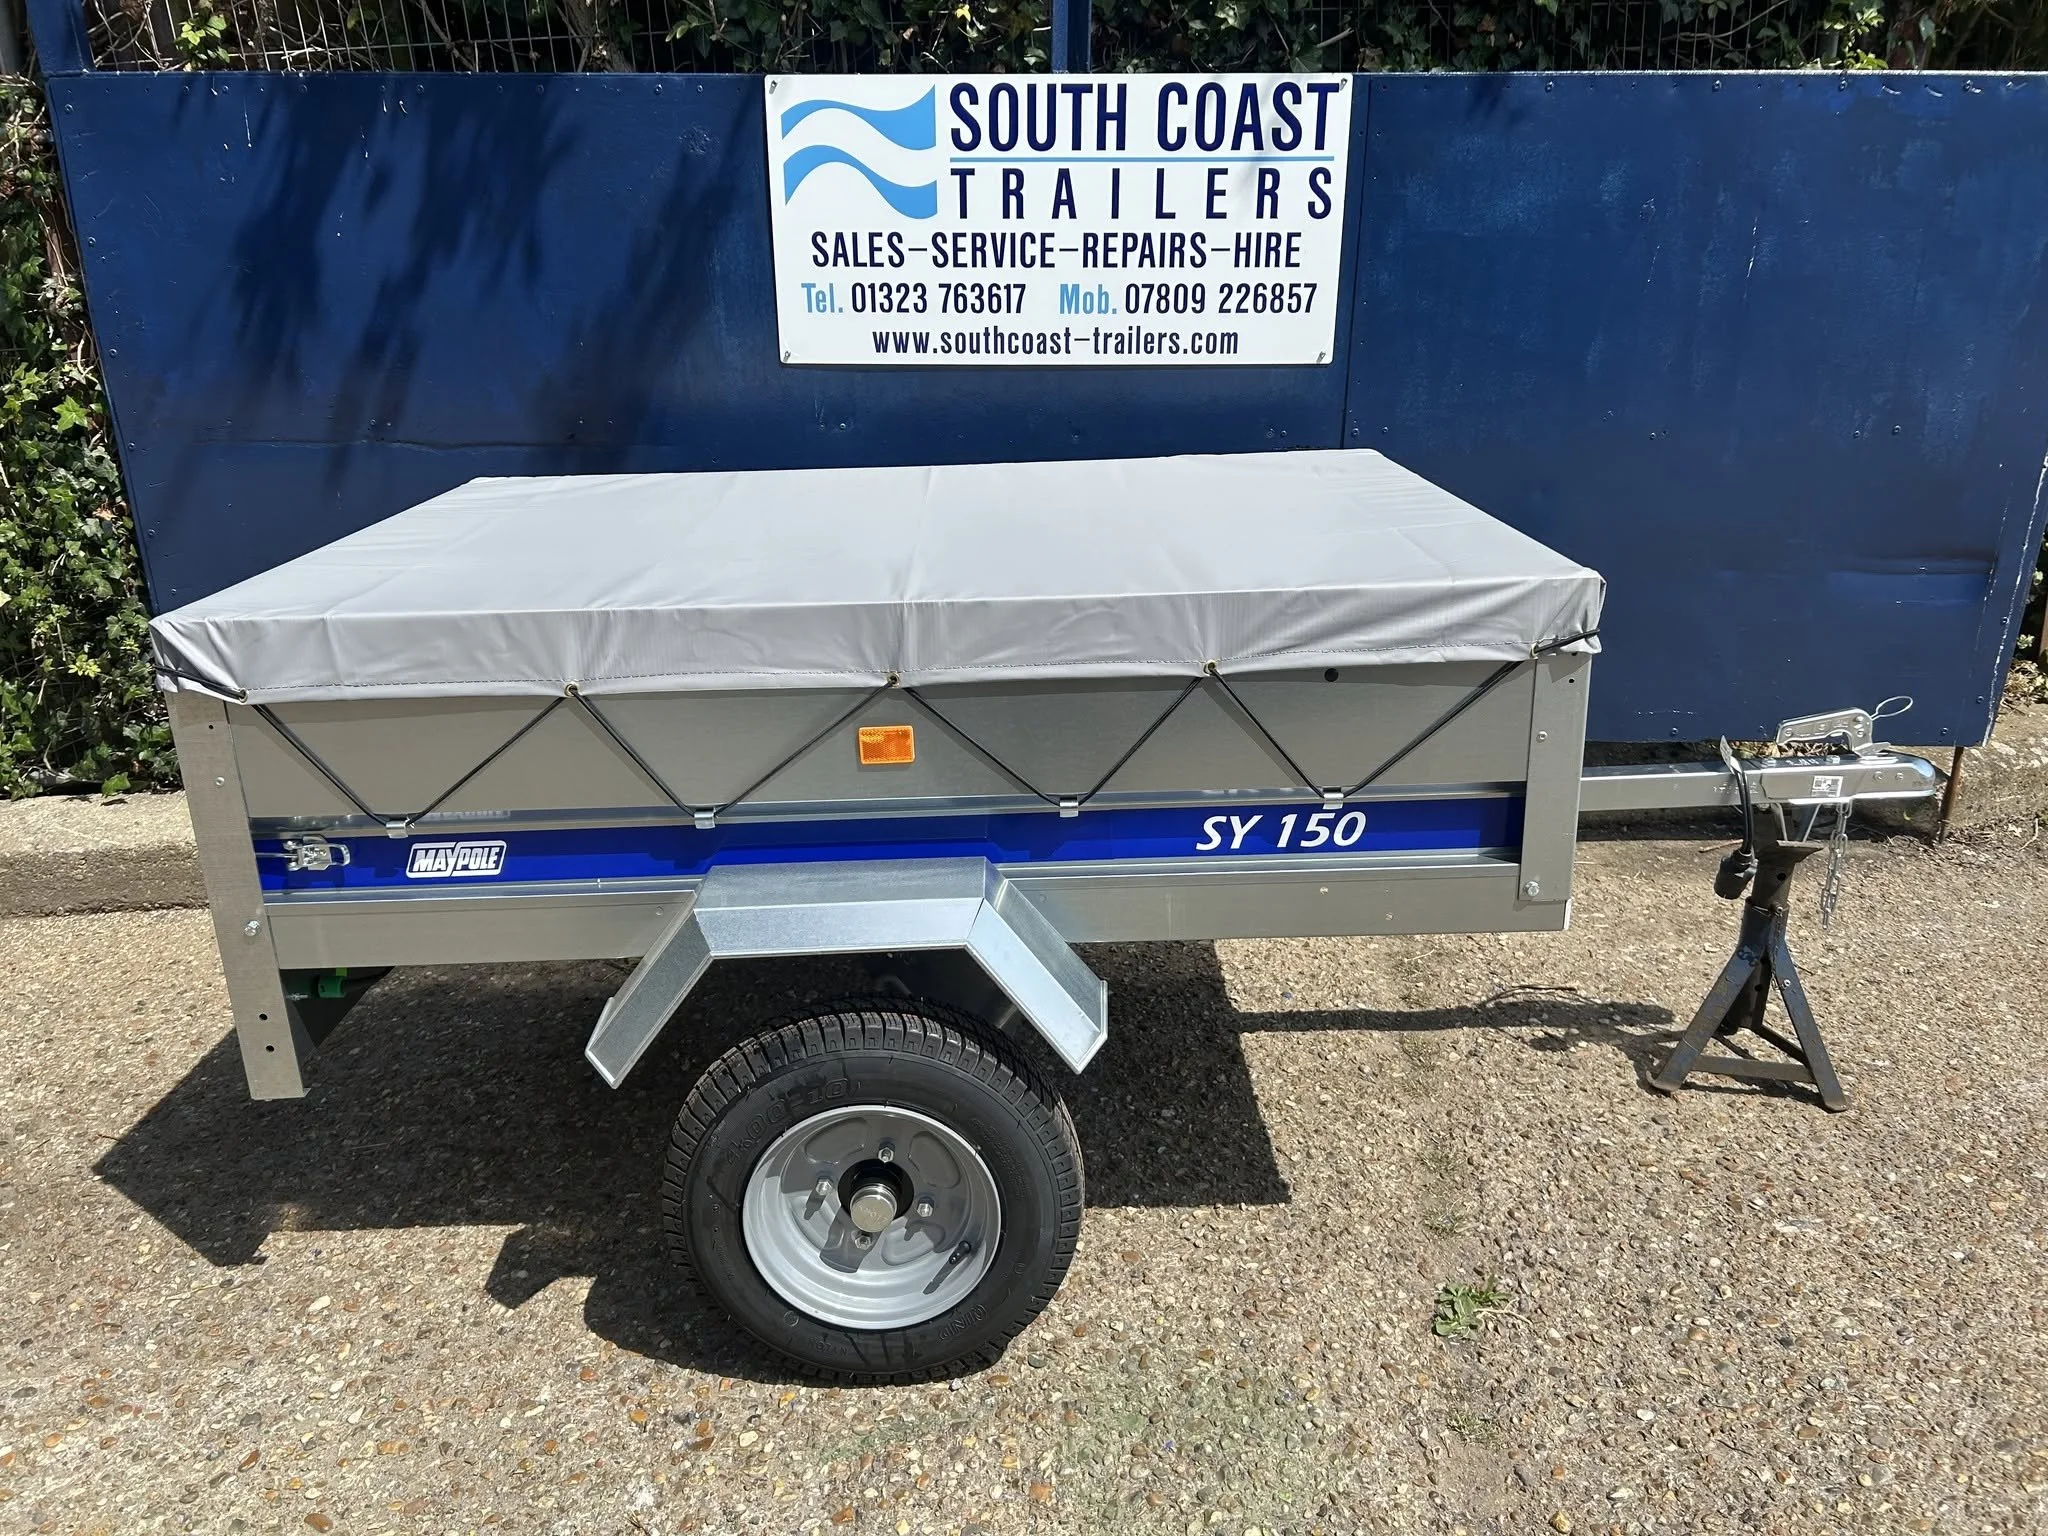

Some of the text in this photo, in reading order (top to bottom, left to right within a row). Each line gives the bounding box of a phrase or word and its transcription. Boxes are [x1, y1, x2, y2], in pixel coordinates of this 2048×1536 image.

[950, 81, 1341, 152] SOUTH COAST
[950, 166, 1333, 220] TRAILERS
[801, 281, 1319, 315] Tel. 01323 763617 Mob. 07809 226857
[872, 325, 1239, 356] www.southcoast-trailers.com
[1195, 811, 1366, 850] SY 150
[411, 845, 502, 875] MAYPOLE
